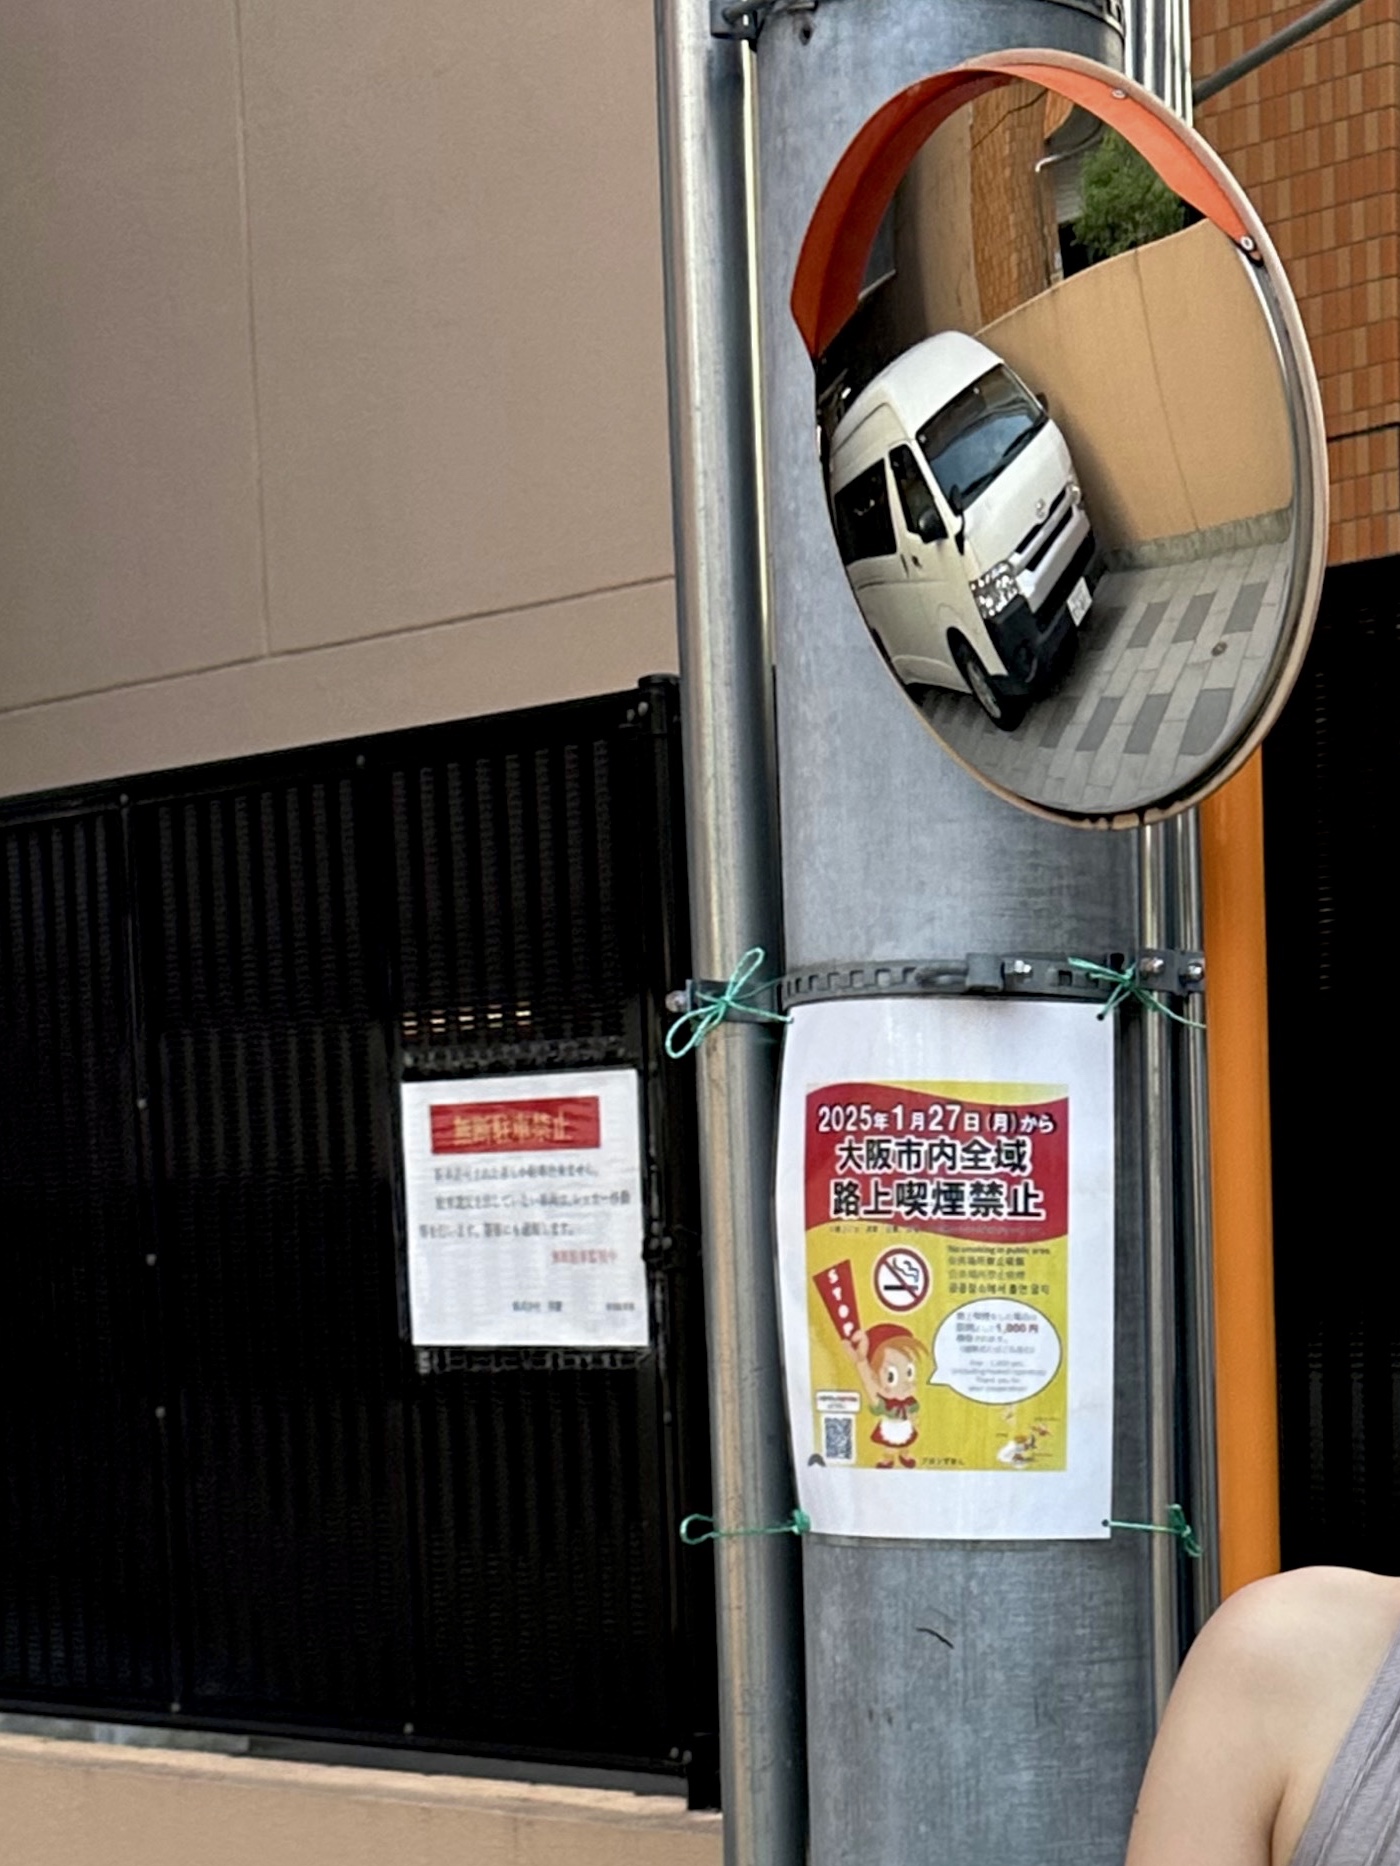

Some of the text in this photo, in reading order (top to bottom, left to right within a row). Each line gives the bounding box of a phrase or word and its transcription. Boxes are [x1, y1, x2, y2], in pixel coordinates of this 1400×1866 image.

[837, 1138, 1029, 1173] 大阪市内全域
[832, 1180, 1043, 1218] 路上喫煙禁止
[827, 1268, 855, 1337] STOP
